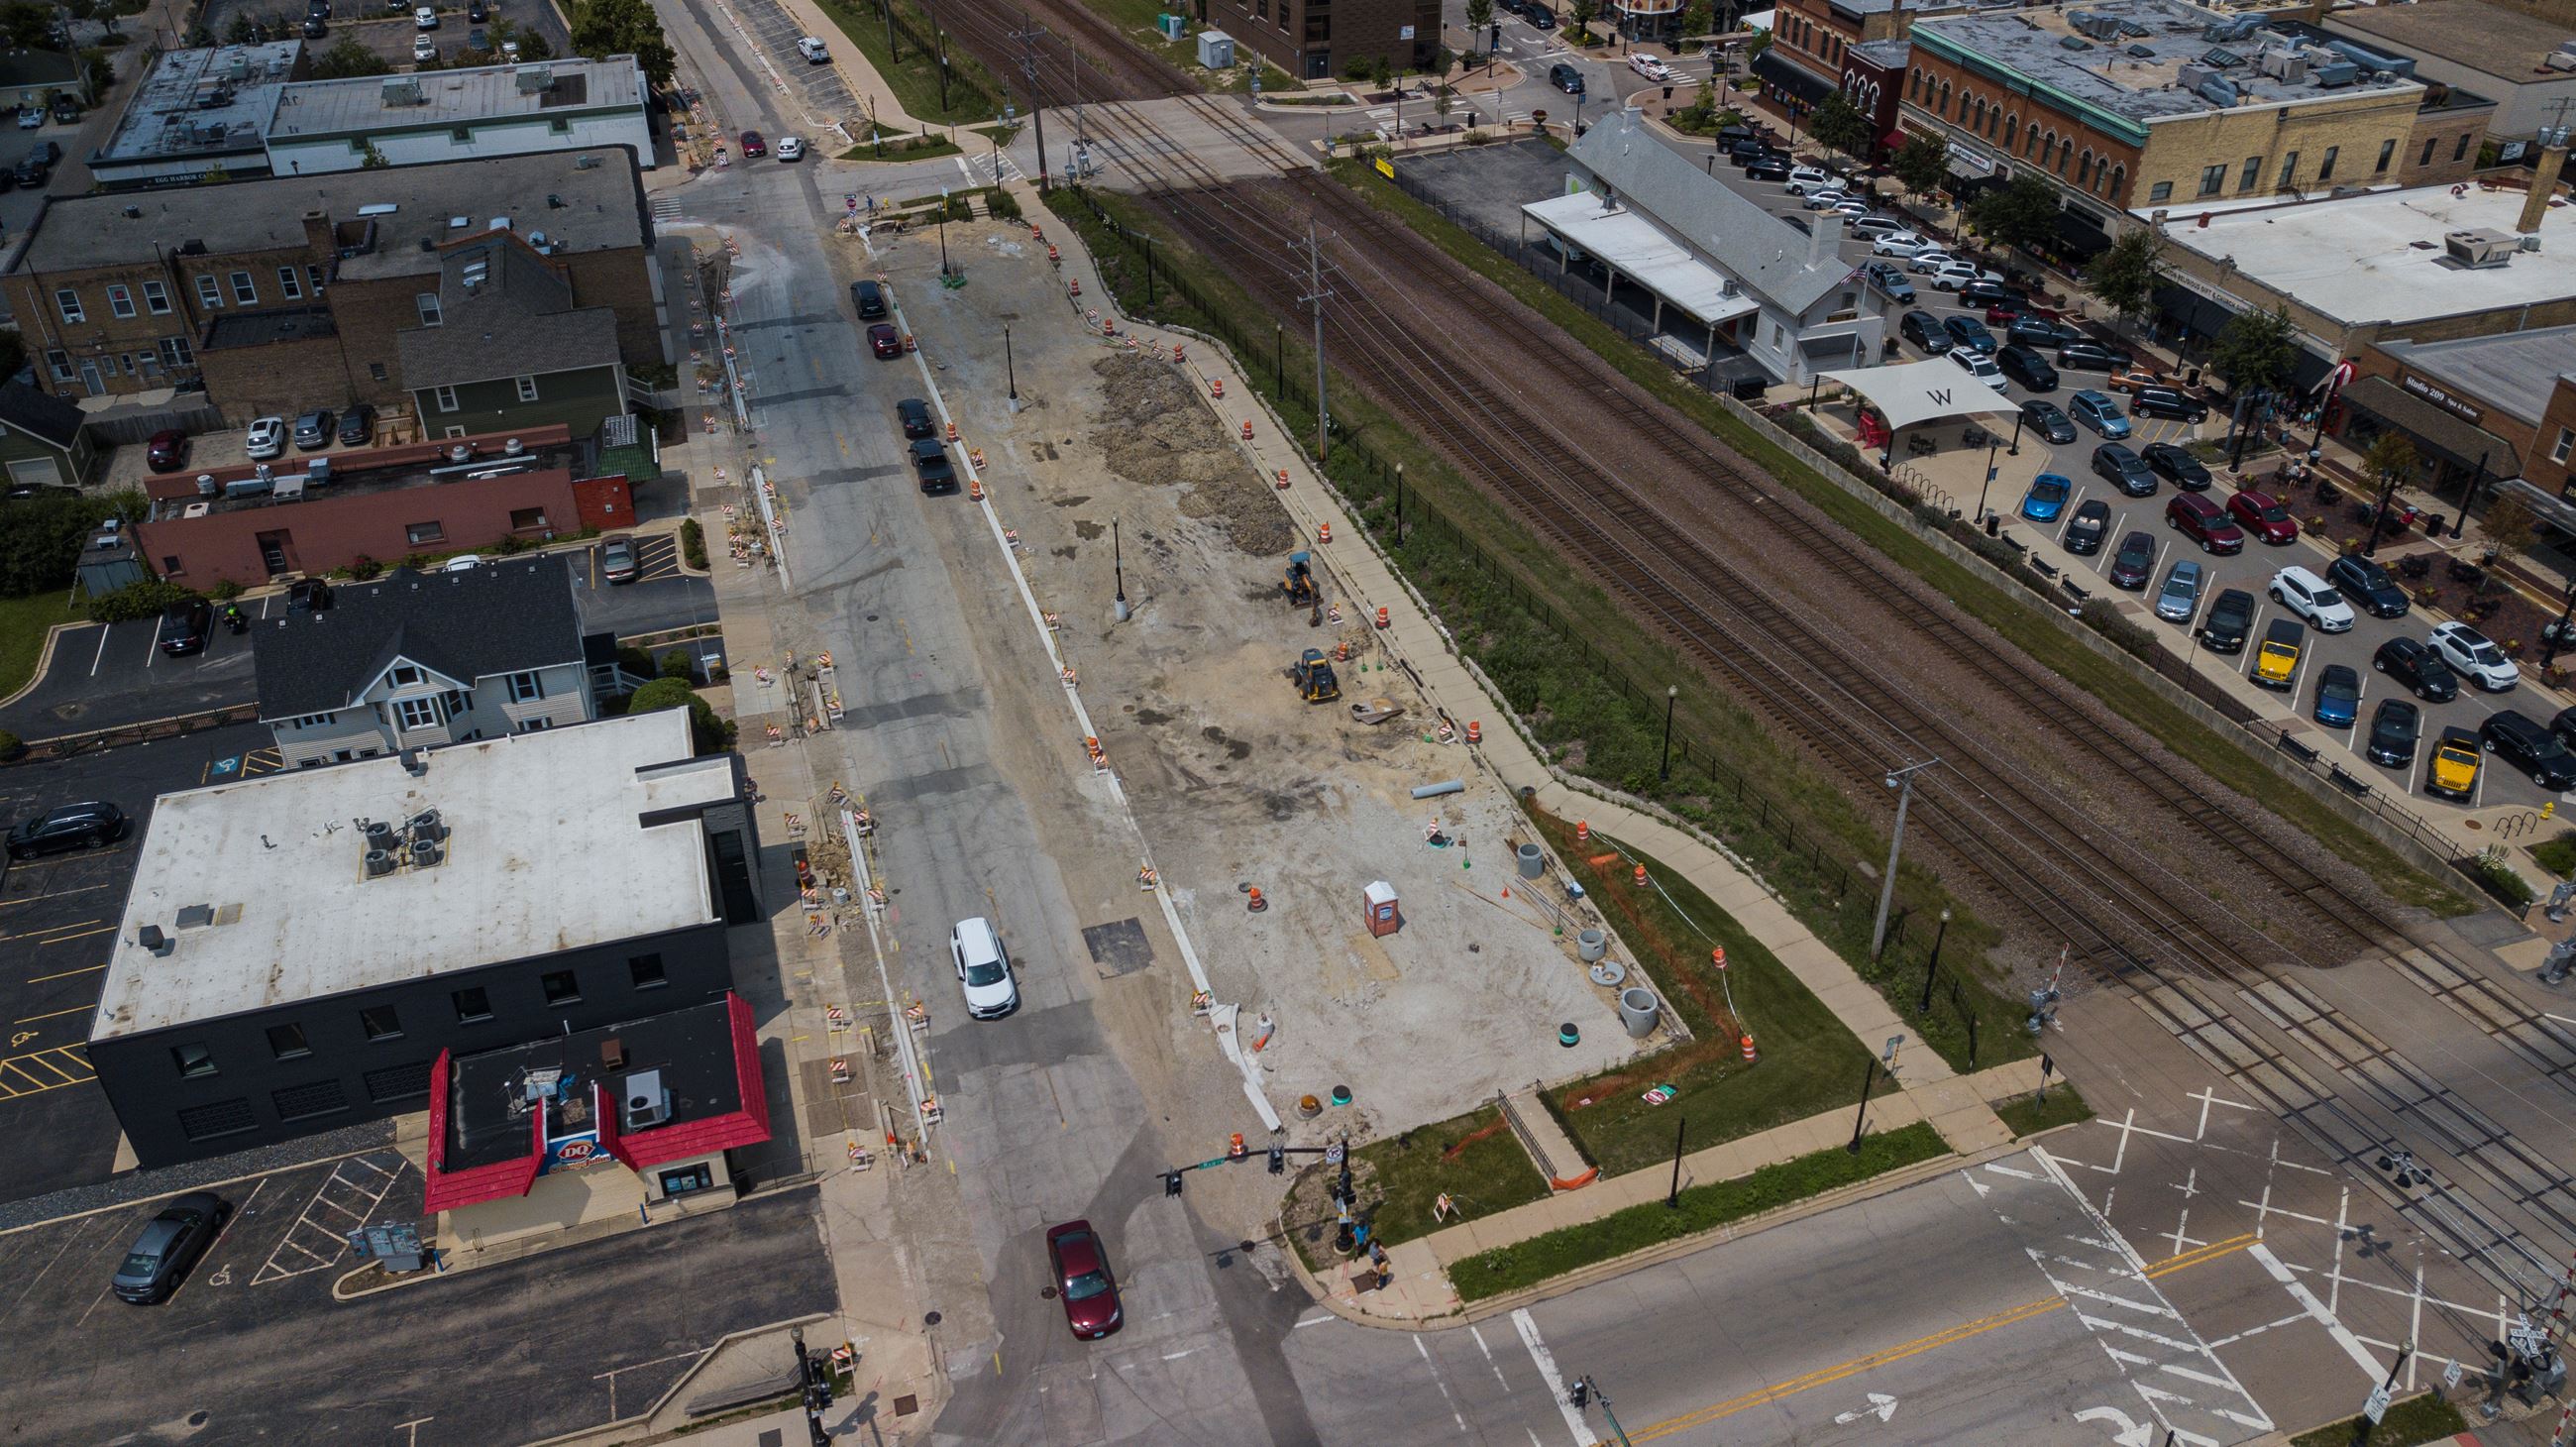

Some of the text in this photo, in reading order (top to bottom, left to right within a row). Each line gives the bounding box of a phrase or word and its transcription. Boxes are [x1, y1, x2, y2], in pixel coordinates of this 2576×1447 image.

[1926, 388, 1951, 406] W
[2406, 376, 2428, 392] Studio
[2429, 388, 2445, 401] 209
[2447, 397, 2457, 408] Spa
[2462, 405, 2478, 417] Salon
[565, 1145, 589, 1158] DQ
[2512, 1329, 2546, 1339] CROSSING
